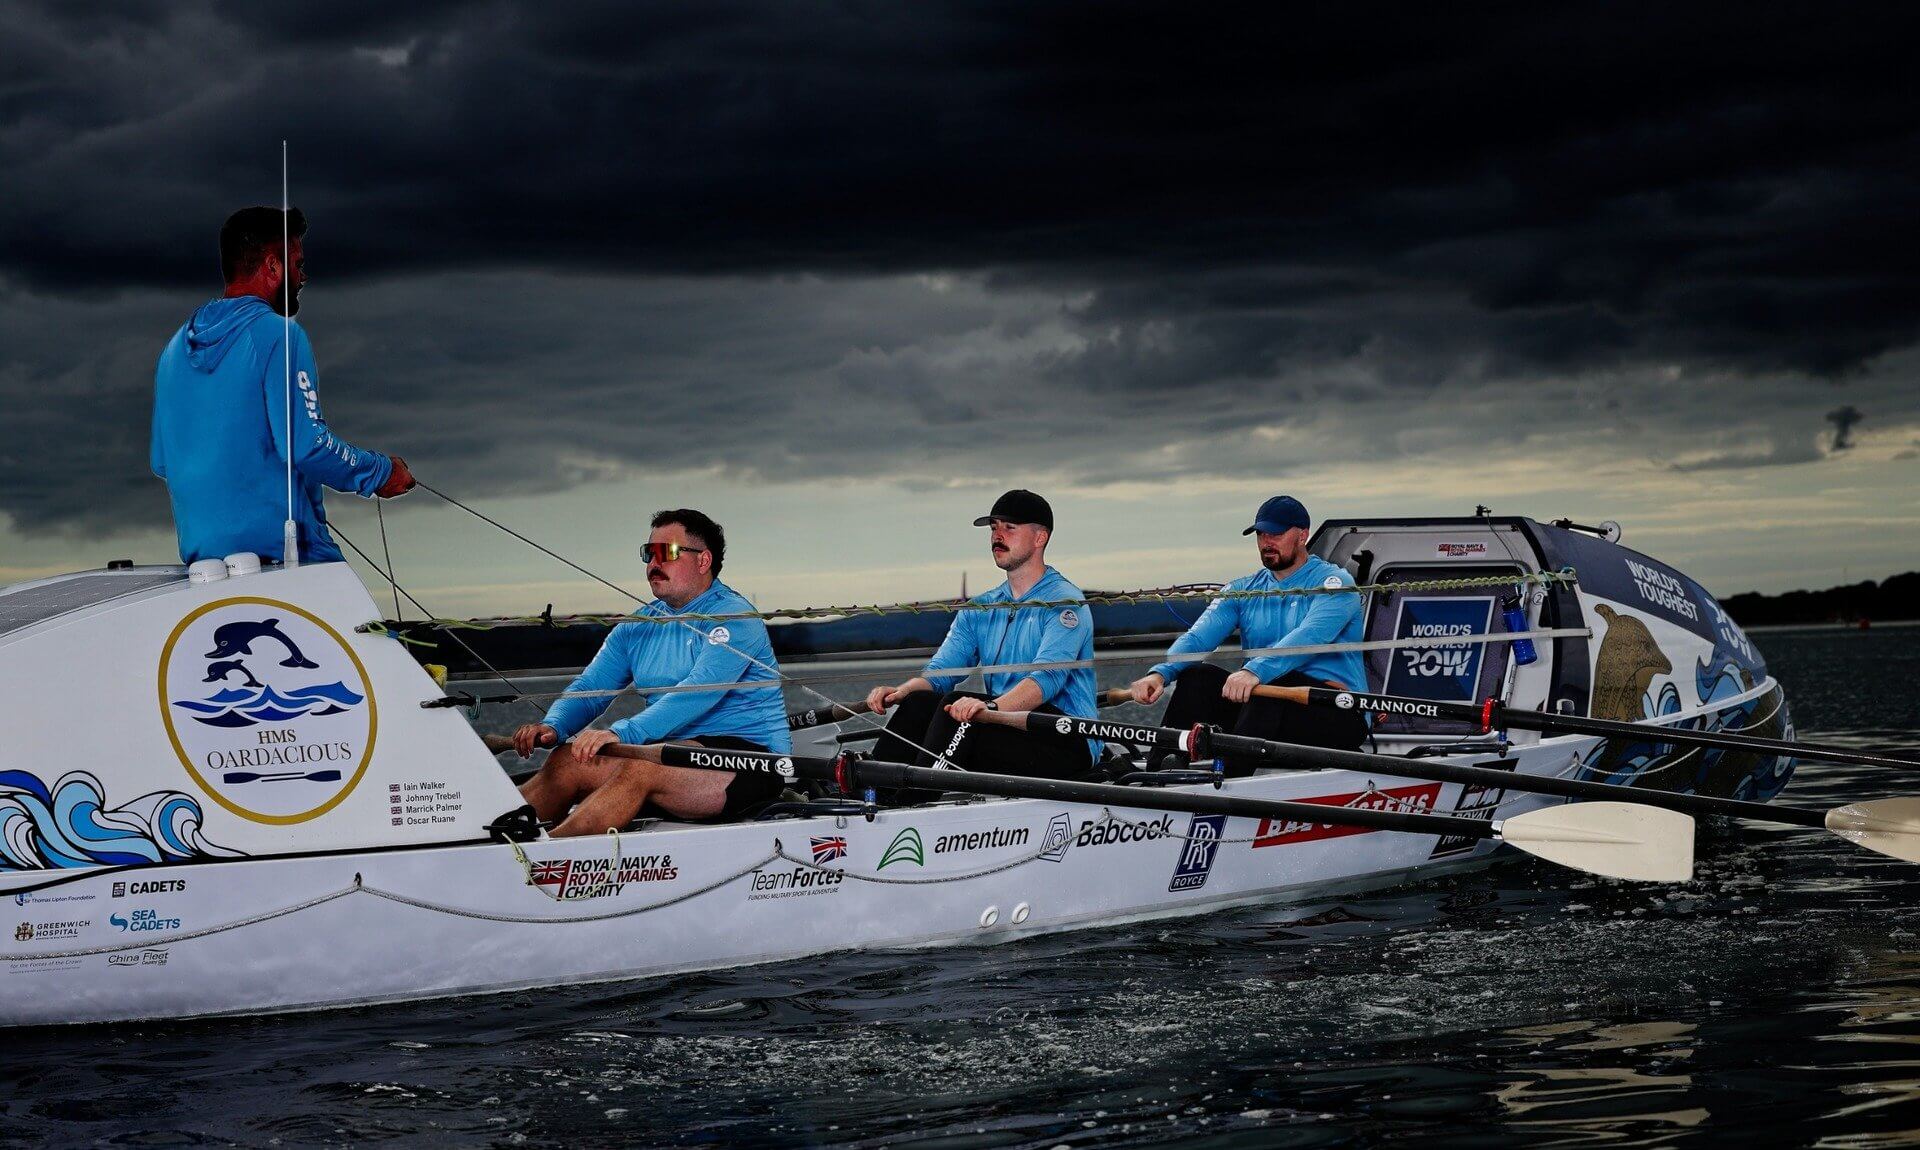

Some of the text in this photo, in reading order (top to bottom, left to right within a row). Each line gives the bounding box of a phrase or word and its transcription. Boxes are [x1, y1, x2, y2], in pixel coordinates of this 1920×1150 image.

[1625, 558, 1684, 597] WORLD'S
[1634, 578, 1698, 622] TOUGHEST
[1412, 624, 1472, 637] WORLD'S
[1402, 650, 1473, 677] ROW
[1359, 698, 1439, 717] RANNOCH
[257, 729, 297, 745] HMS
[945, 721, 972, 757] balance
[1078, 721, 1158, 743] RANNOCH
[207, 742, 352, 770] OARDACIOUS
[690, 752, 770, 772] RANNOCH
[403, 781, 446, 791] Iain Walker
[405, 791, 461, 803] Johnny Trebell
[406, 803, 462, 814] Marrick Palmer
[406, 815, 456, 825] Oscar Ruane
[1076, 814, 1174, 848] Babcock
[935, 826, 1030, 854] amentum
[620, 854, 660, 870] NAVY
[661, 854, 672, 868] &
[616, 867, 679, 884] MARINES
[751, 867, 845, 892] TeamForces
[1173, 875, 1204, 888] ROYCE
[130, 879, 186, 894] CADETS
[565, 884, 625, 900] CHARITY
[748, 893, 771, 901] FUNDING
[771, 892, 791, 900] MILITARY
[811, 887, 840, 896] ADVENTURE
[132, 909, 157, 921] SEA
[36, 928, 79, 937] HOSPITAL
[37, 920, 91, 930] GREENWICH
[130, 918, 181, 932] CADETS
[108, 952, 169, 963] China Fleet
